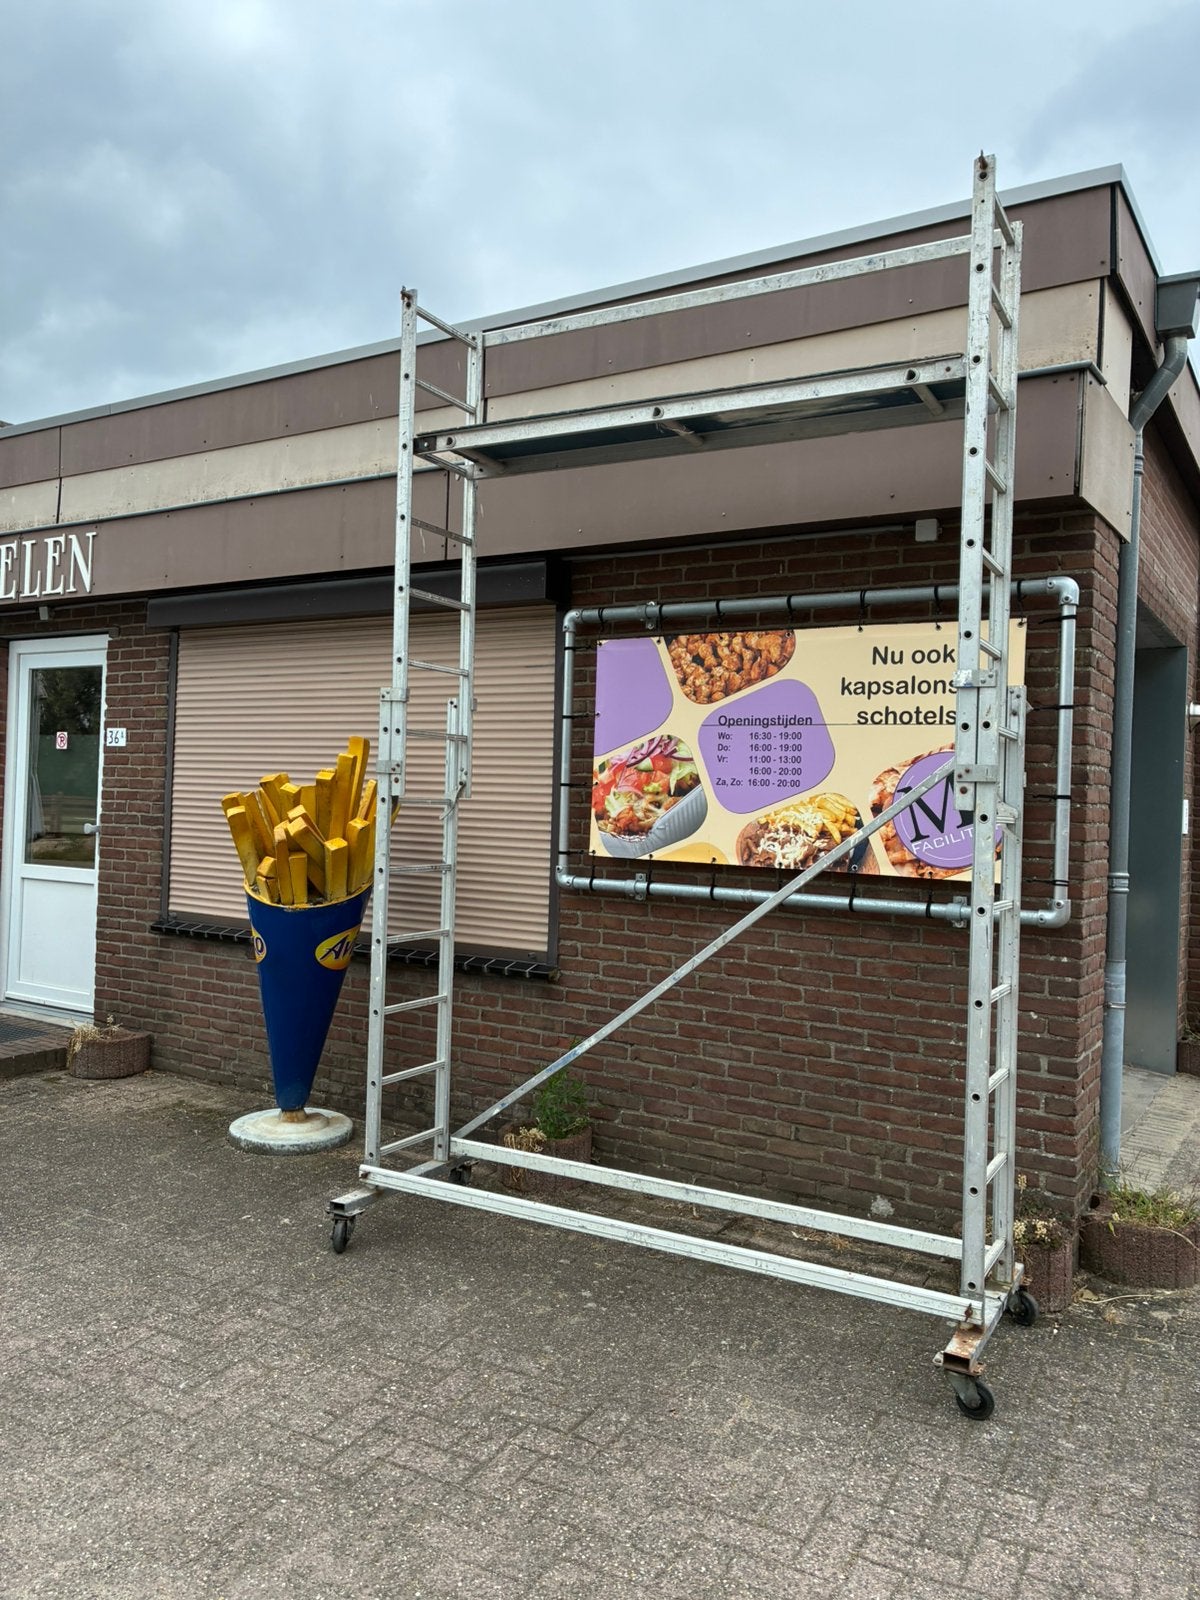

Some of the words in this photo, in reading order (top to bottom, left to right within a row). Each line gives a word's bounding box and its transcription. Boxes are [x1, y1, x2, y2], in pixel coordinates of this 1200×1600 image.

[872, 646, 904, 665] Nu
[911, 644, 955, 664] ook
[840, 675, 958, 700] kapsalons
[857, 705, 956, 725] schotels
[718, 715, 813, 728] Openingstijden
[718, 732, 733, 740] Wo:
[749, 732, 772, 740] 16:30
[779, 732, 802, 740] 19:00
[749, 744, 772, 752] 16:00
[779, 744, 802, 752] 19:00
[717, 755, 728, 763] Vr:
[778, 756, 802, 764] 13:00
[749, 767, 772, 775] 16:00
[778, 767, 802, 776] 20:00
[716, 778, 729, 787] Za,
[730, 778, 744, 787] Zo:
[748, 779, 770, 787] 16:00
[777, 779, 801, 787] 20:00
[911, 827, 973, 855] FACILIT
